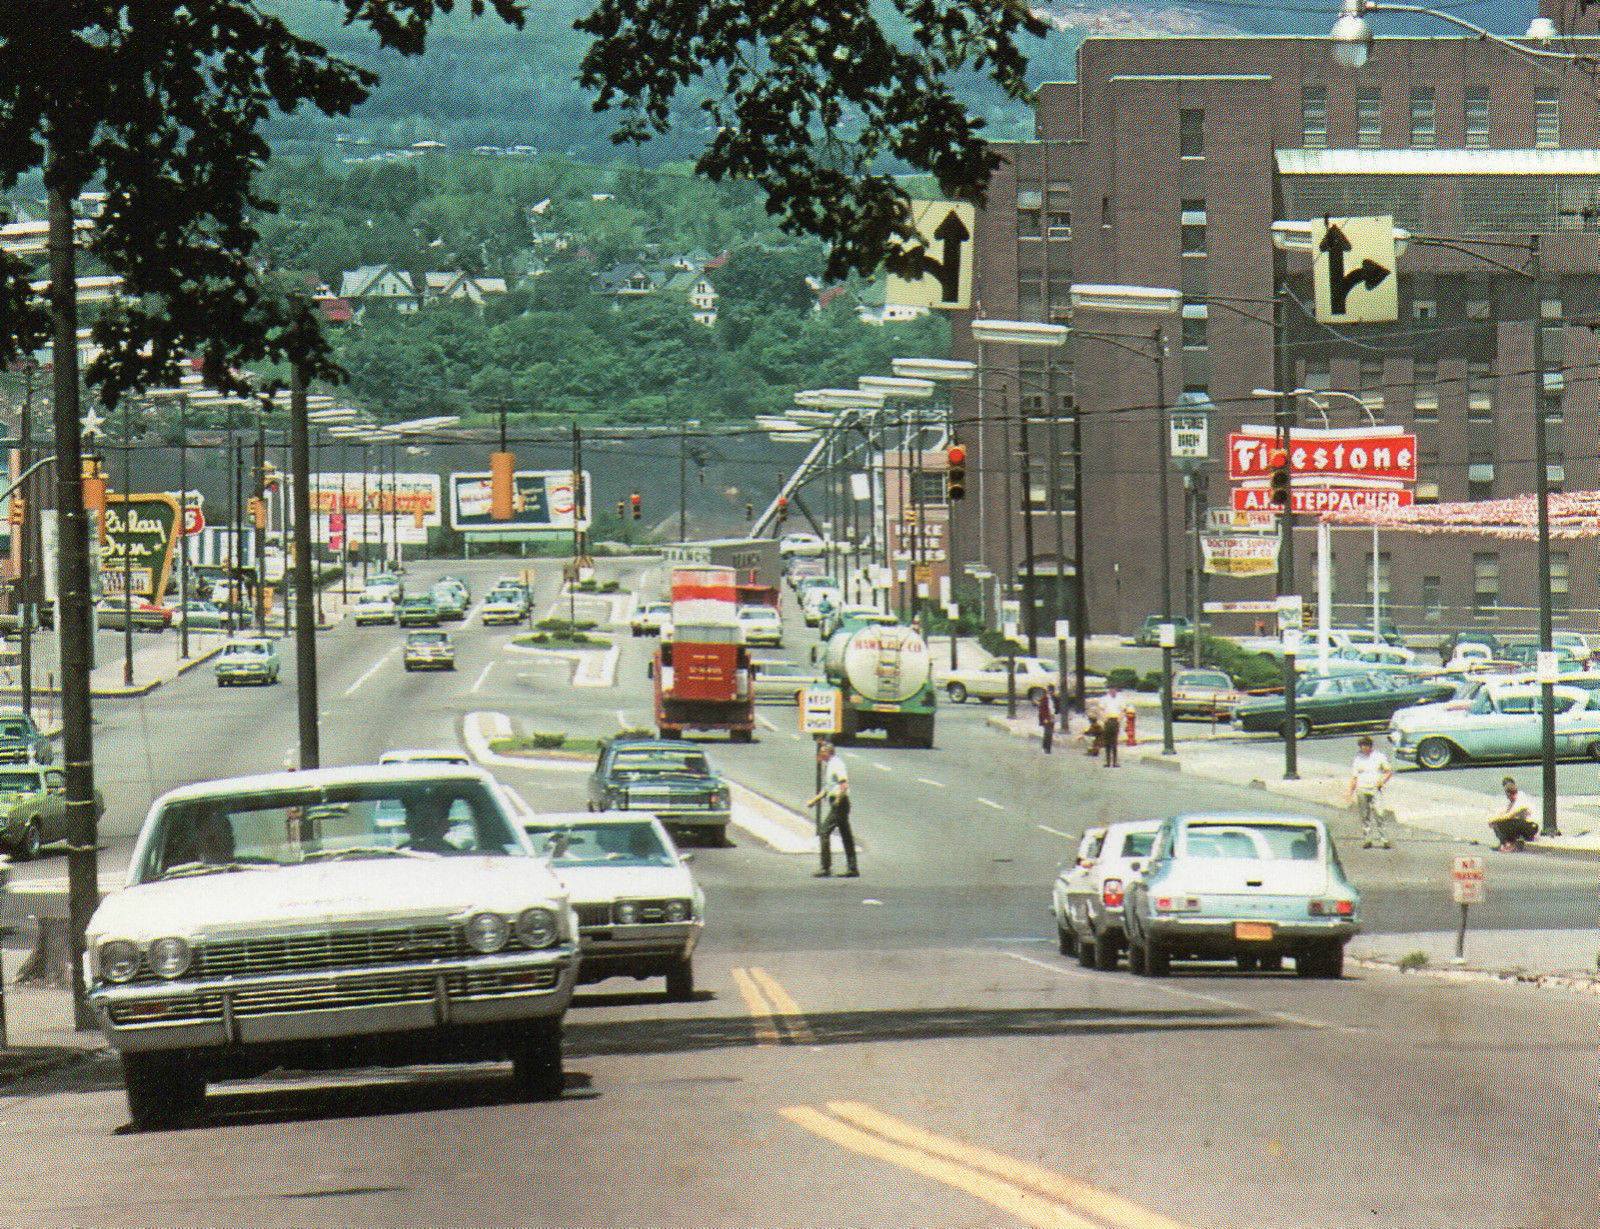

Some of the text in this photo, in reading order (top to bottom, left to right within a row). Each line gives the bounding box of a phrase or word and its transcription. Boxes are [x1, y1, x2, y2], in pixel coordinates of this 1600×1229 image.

[1233, 439, 1412, 472] Fiestone
[1284, 490, 1400, 511] TEPPACHER
[807, 695, 832, 705] KEEP
